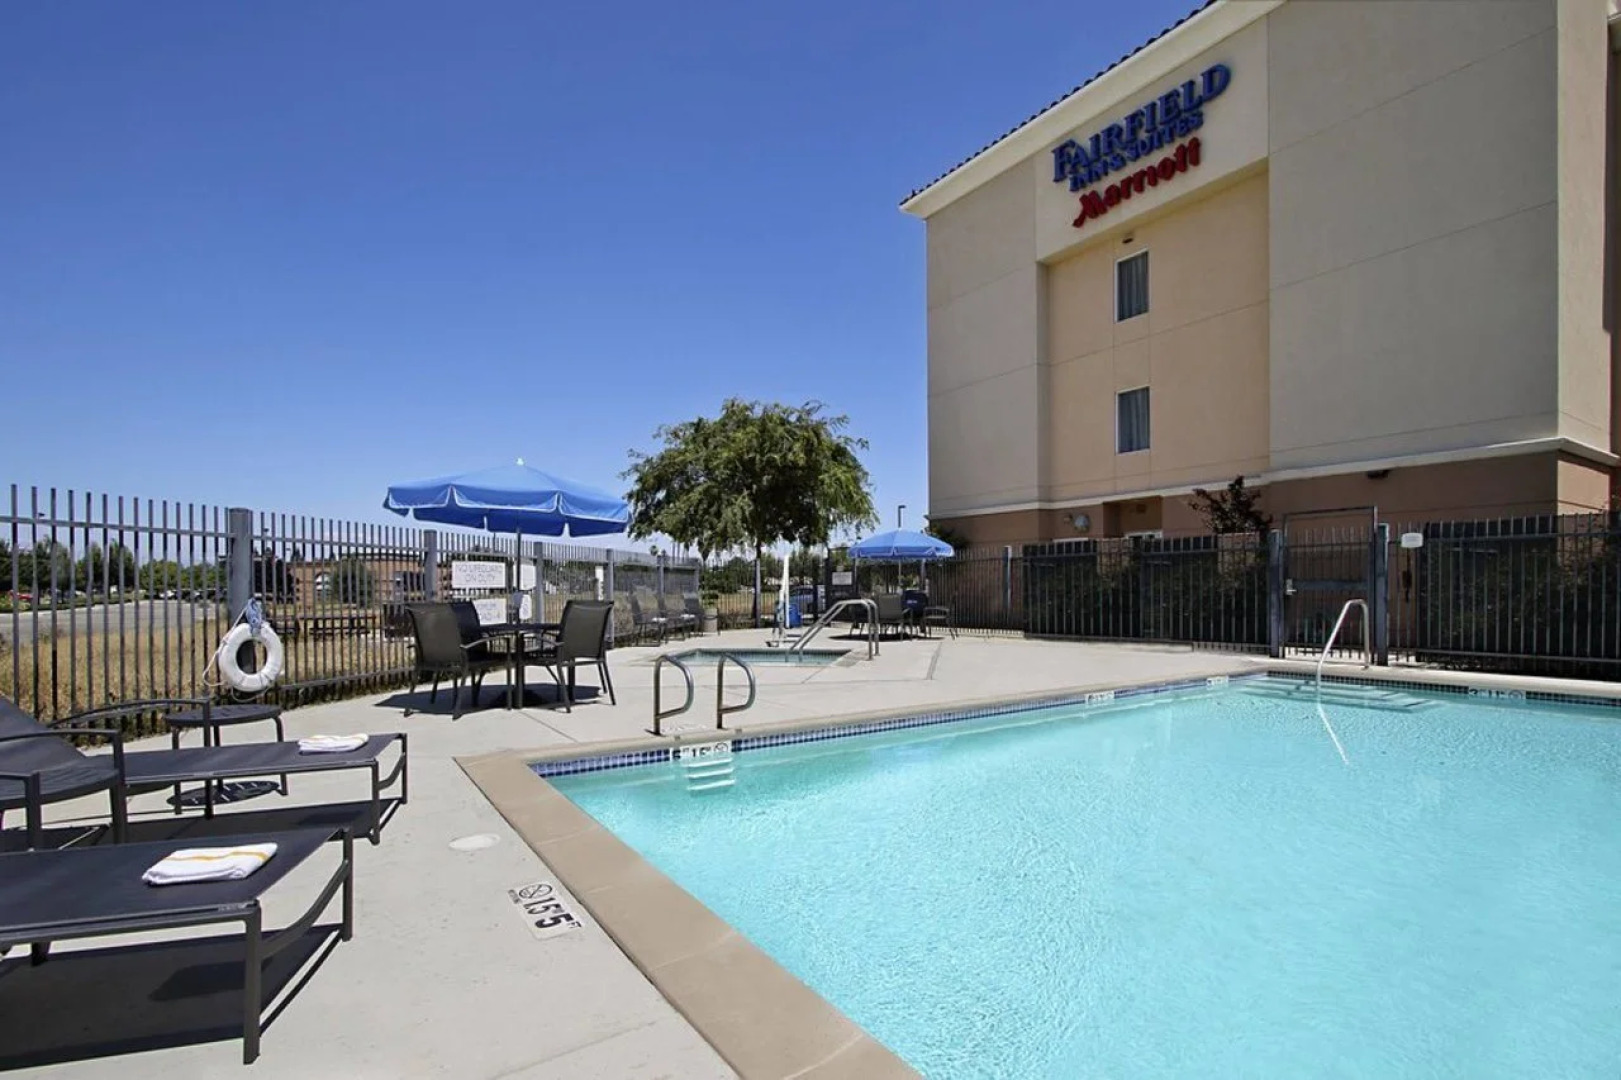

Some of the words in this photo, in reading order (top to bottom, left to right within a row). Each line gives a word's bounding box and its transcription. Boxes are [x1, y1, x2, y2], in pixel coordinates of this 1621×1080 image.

[1052, 64, 1231, 182] FAIRFIELD
[1126, 111, 1204, 162] SUITES
[1072, 137, 1201, 228] Marriott
[534, 913, 574, 929] 5
